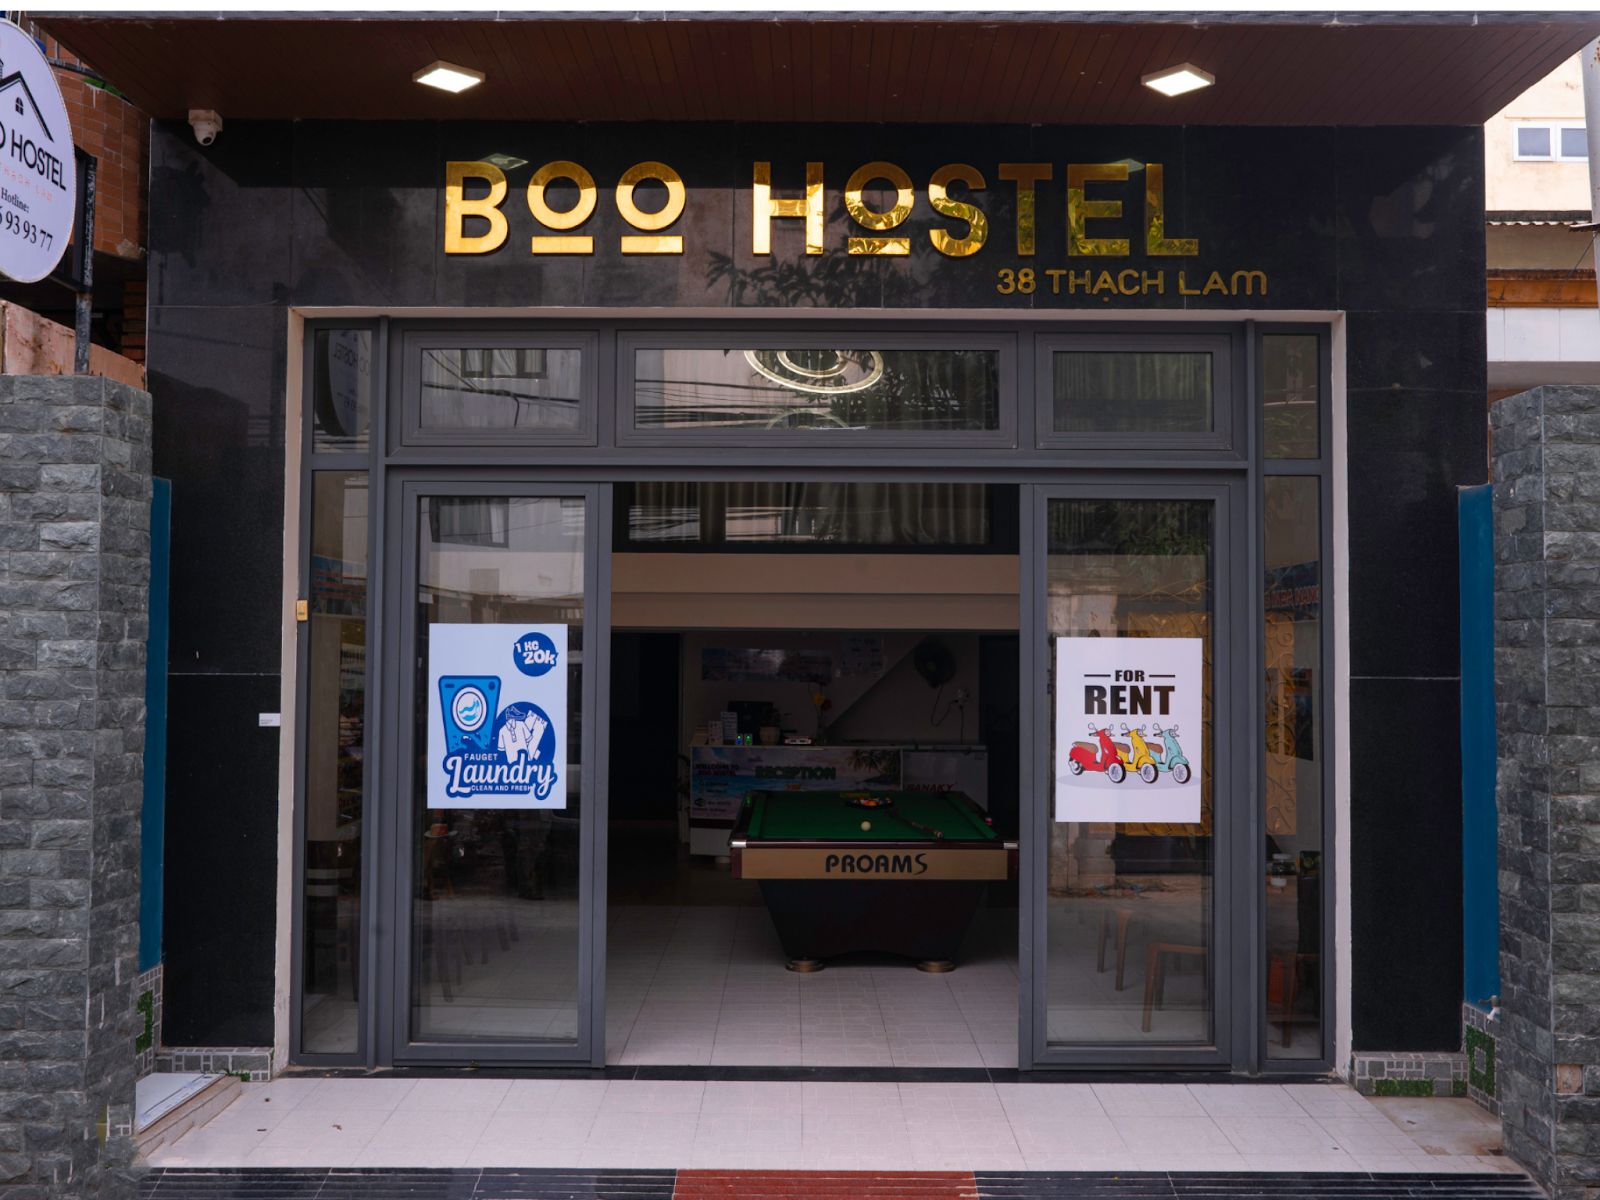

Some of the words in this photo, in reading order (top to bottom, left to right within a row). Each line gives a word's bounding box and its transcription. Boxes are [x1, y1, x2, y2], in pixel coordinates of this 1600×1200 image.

[11, 129, 66, 191] HOSTEL
[1, 187, 29, 213] Hotline:
[444, 161, 687, 255] BOO
[751, 161, 1198, 257] HOSTEL
[996, 267, 1036, 295] 38
[515, 642, 522, 653] 1
[524, 640, 539, 651] KG
[1115, 670, 1145, 682] FOR
[1084, 685, 1175, 715] RENT
[464, 753, 498, 761] FAUGET
[446, 752, 554, 796] Laundry
[825, 853, 928, 876] PROAMS
